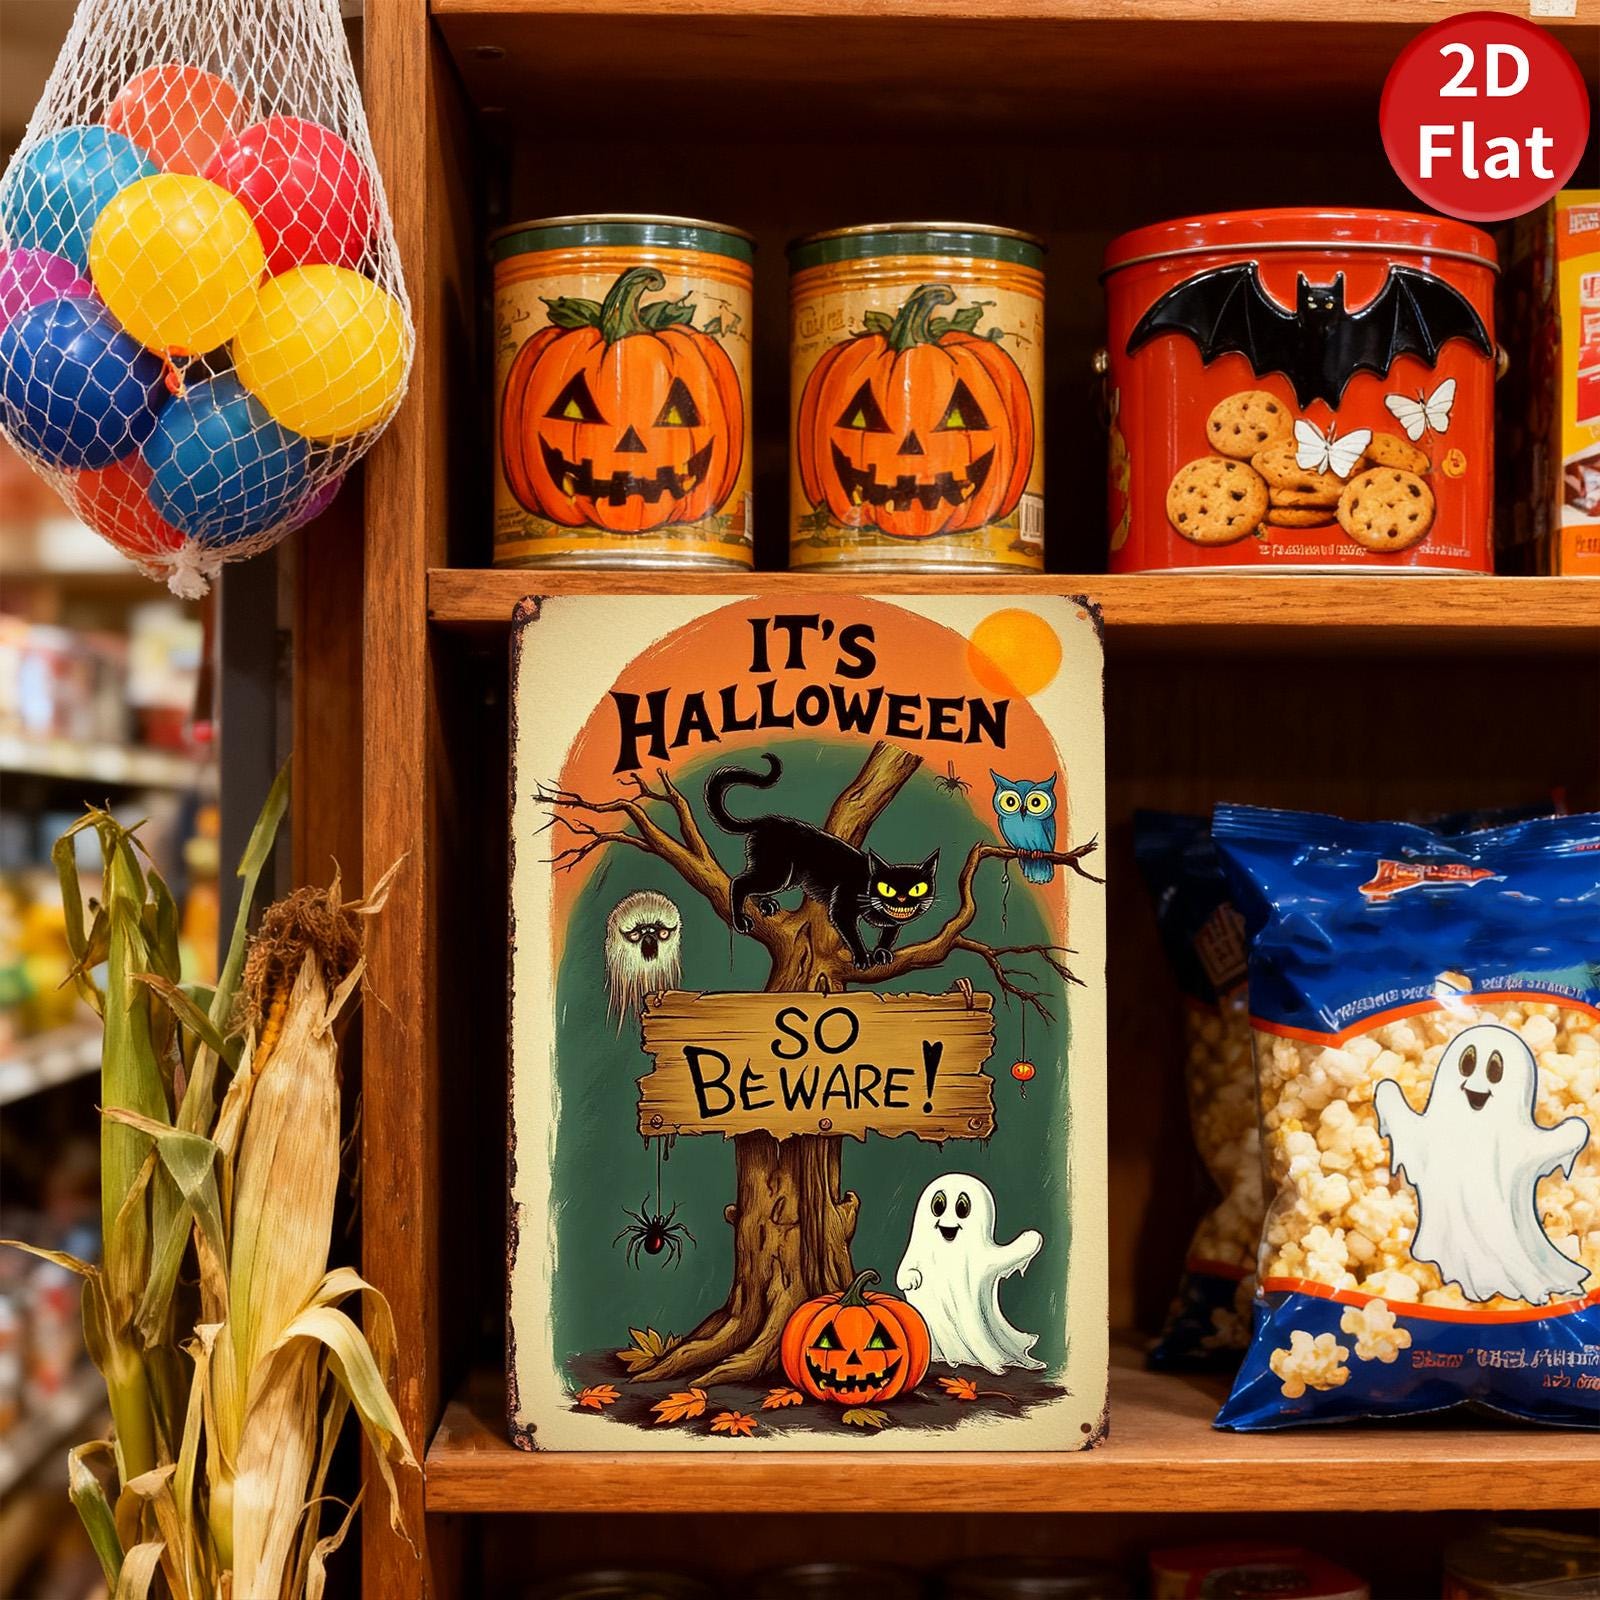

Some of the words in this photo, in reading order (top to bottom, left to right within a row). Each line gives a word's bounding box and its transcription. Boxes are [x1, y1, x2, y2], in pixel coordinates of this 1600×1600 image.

[747, 613, 877, 679] IT'S
[608, 678, 1011, 775] HALLOWEEN
[770, 1006, 860, 1060] SO
[682, 1040, 944, 1119] BEWARE!
